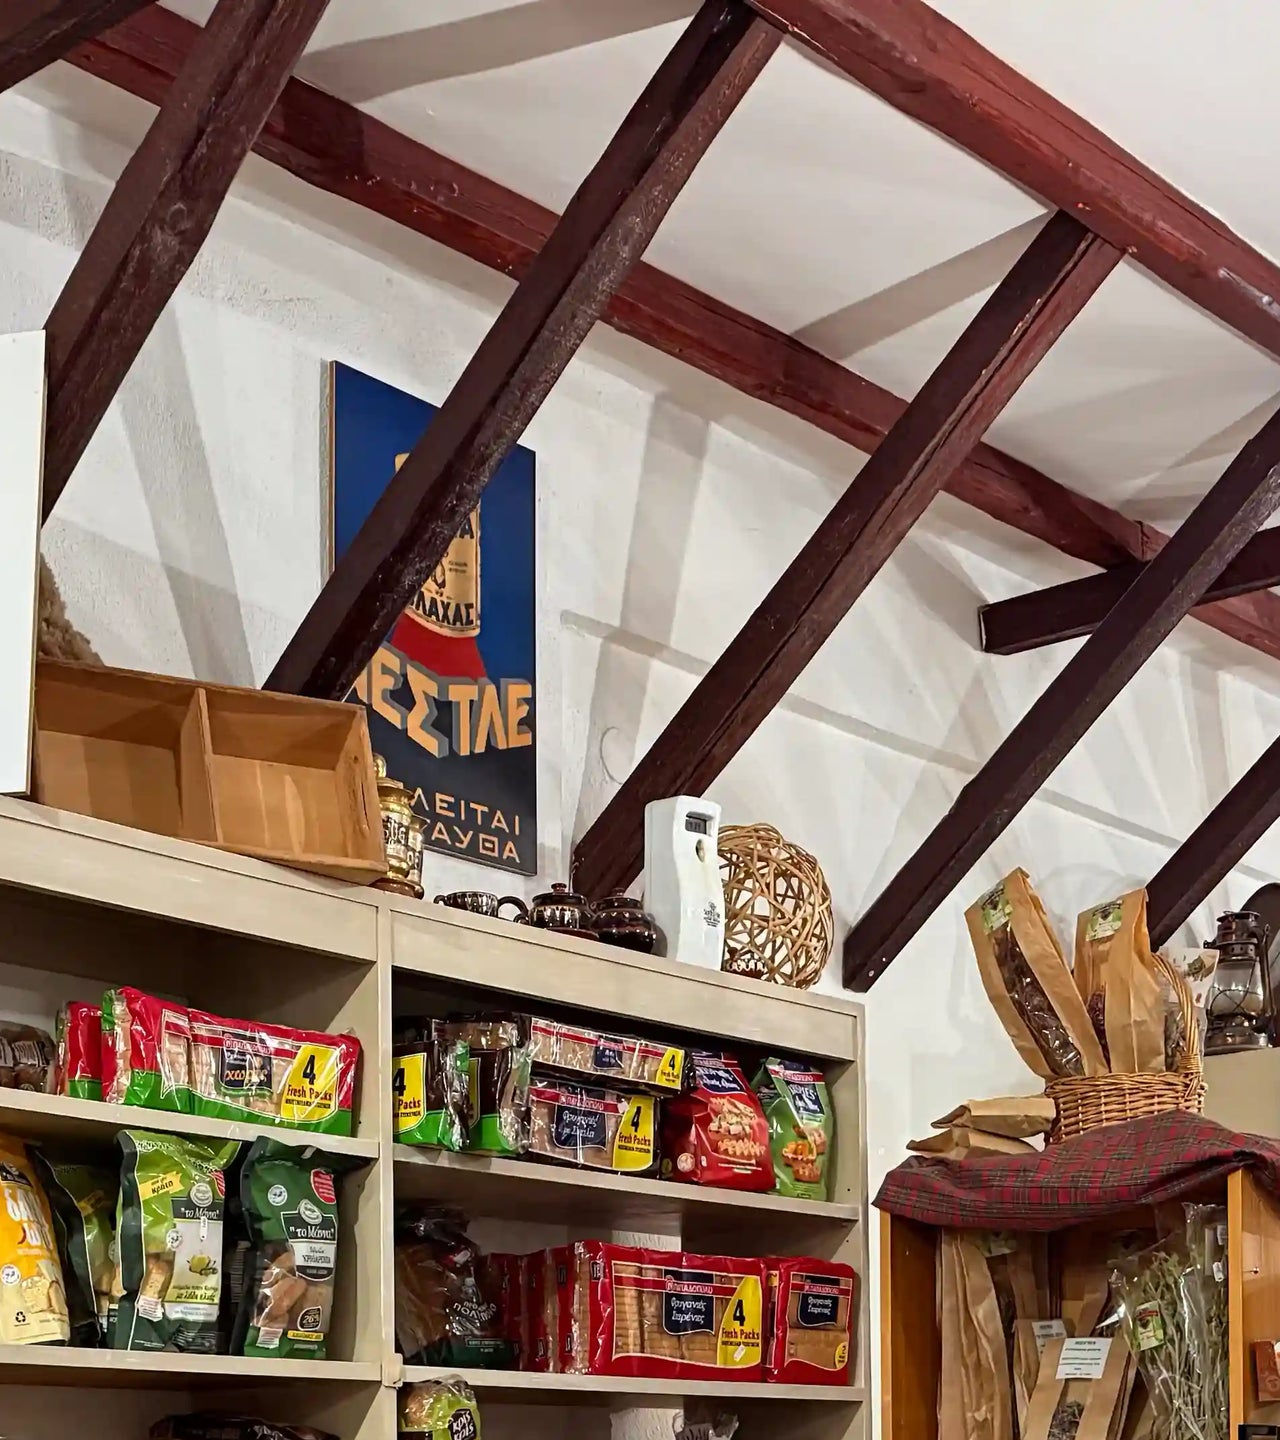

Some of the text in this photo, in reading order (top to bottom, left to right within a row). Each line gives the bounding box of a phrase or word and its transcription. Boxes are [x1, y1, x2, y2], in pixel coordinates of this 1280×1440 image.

[303, 1055, 316, 1085] 4
[287, 1085, 332, 1101] Fresh Packs
[631, 1106, 641, 1132] 4
[619, 1132, 650, 1146] Fresh Packs
[733, 1299, 745, 1327] 4
[722, 1328, 760, 1340] Fresh Packs
